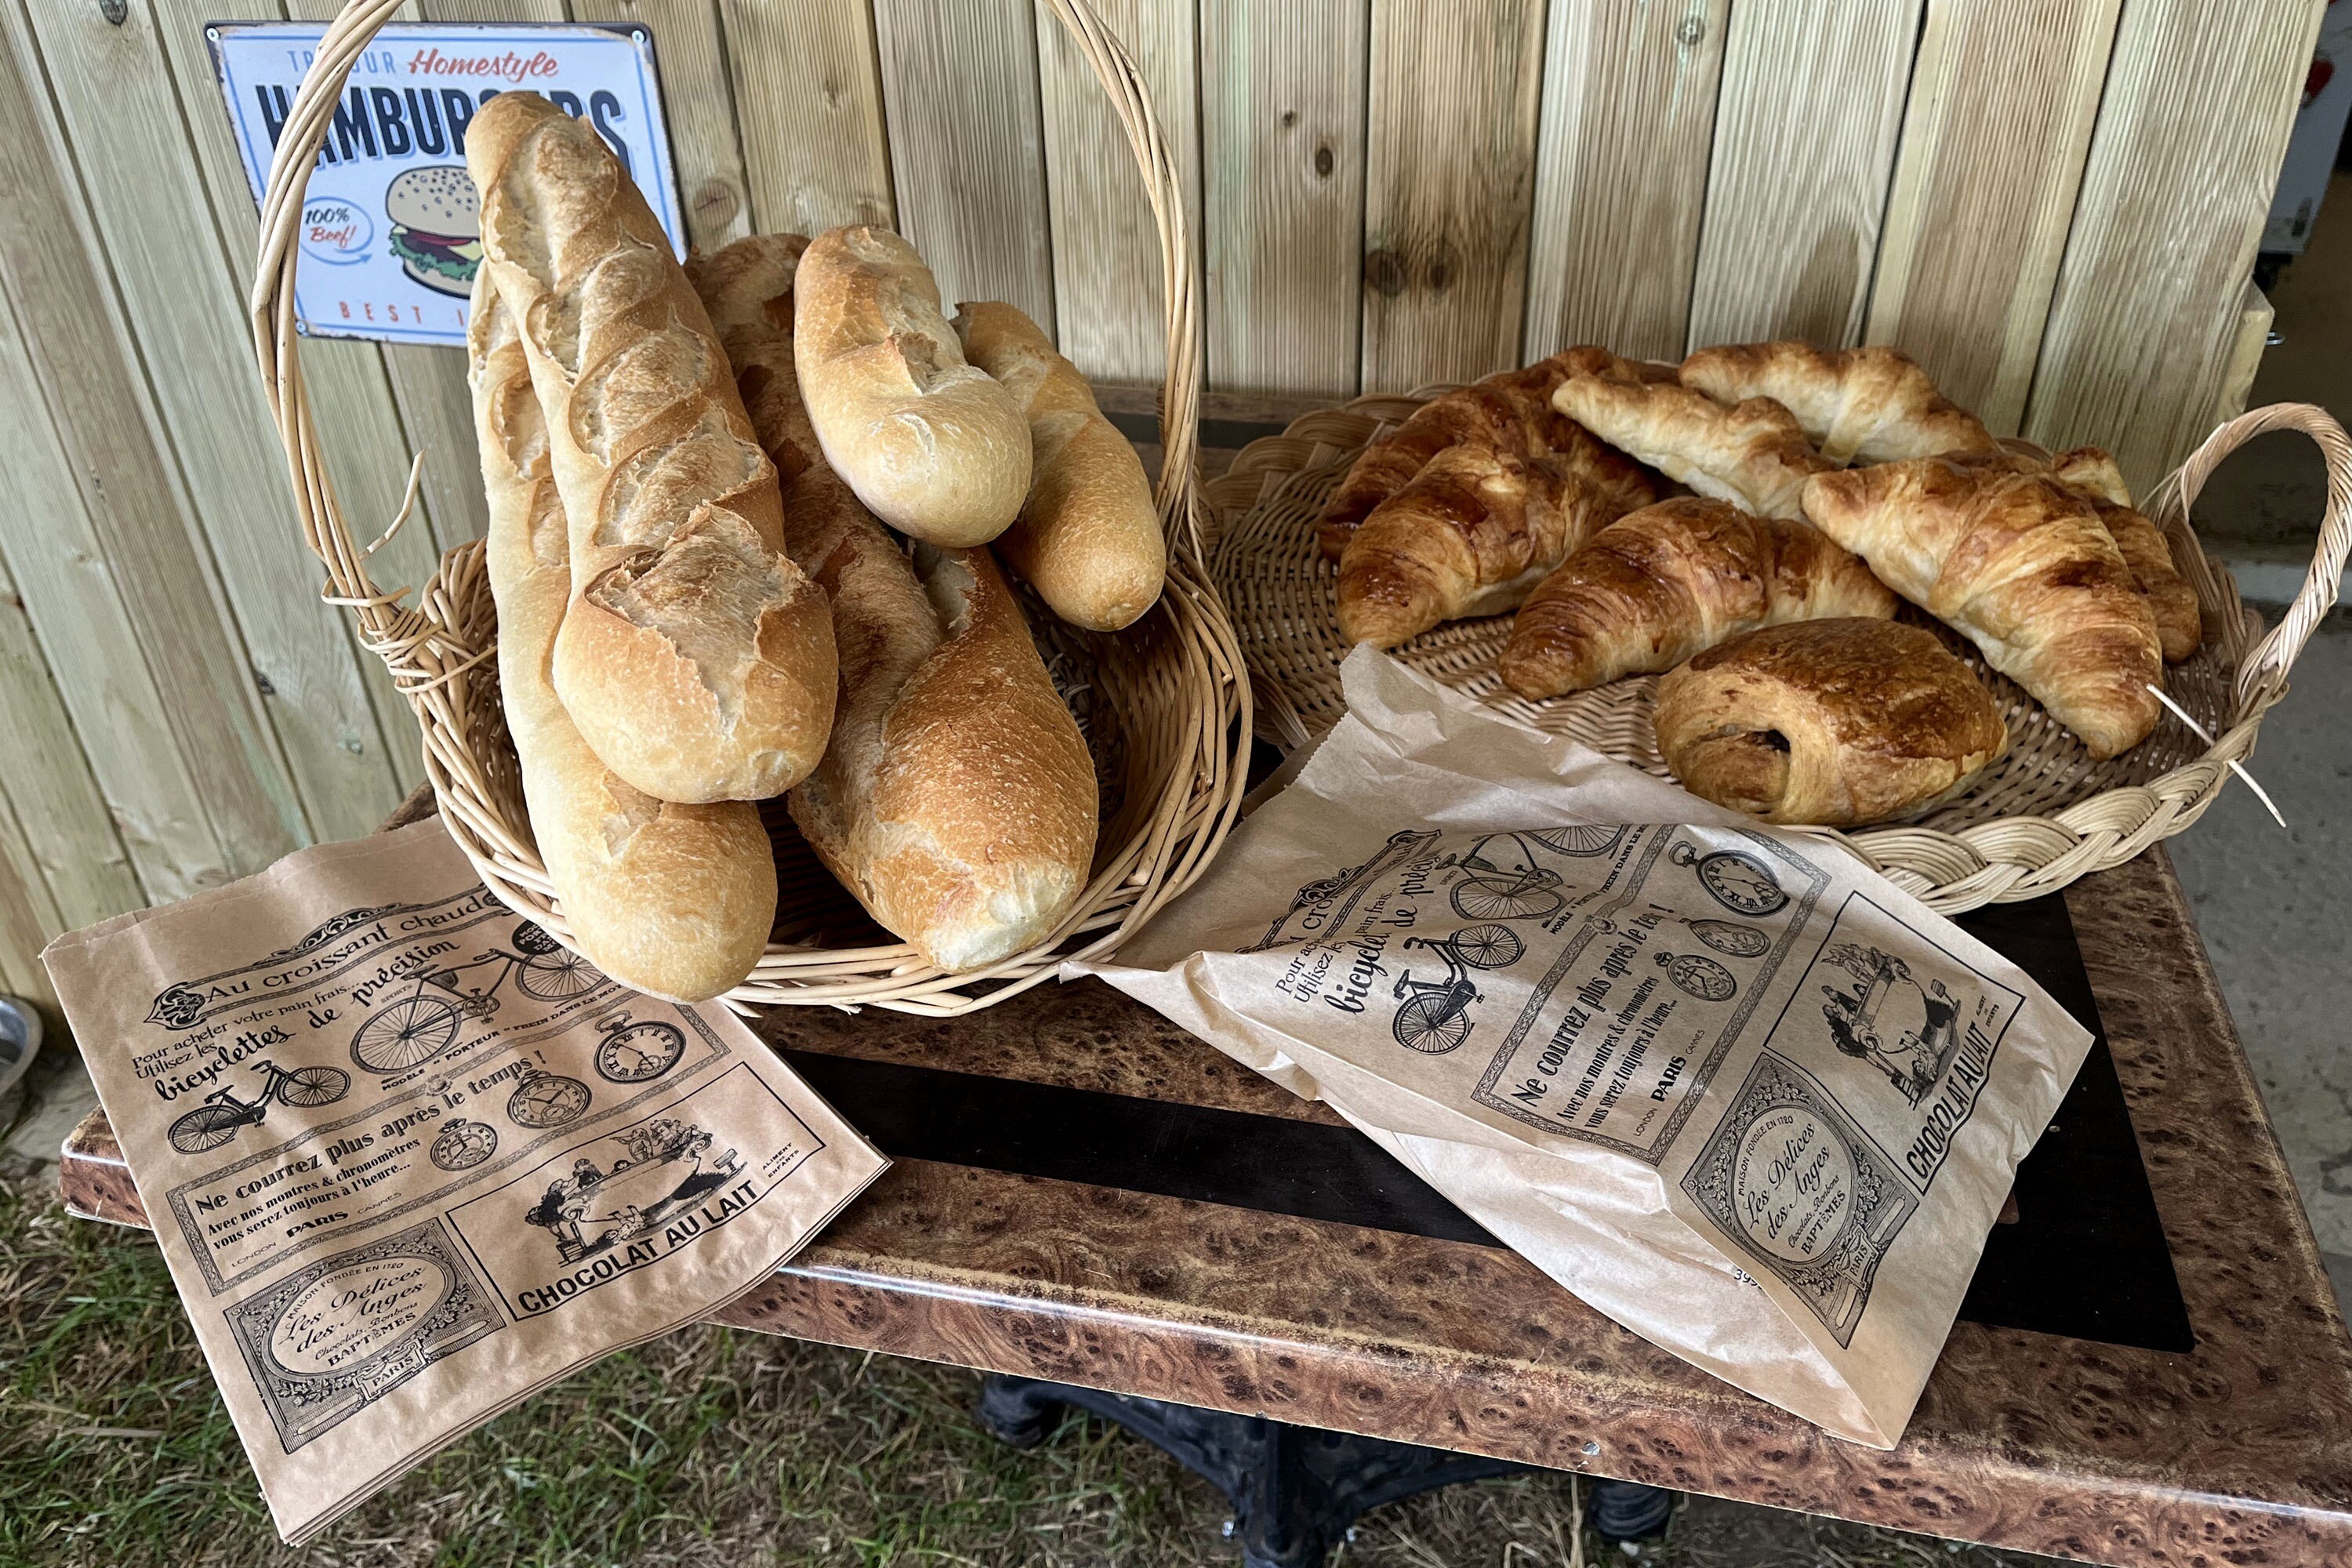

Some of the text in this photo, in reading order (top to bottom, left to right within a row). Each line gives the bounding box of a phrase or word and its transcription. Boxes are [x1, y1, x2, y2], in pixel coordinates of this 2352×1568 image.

[408, 48, 559, 83] Homestyle
[305, 207, 350, 225] 100%
[310, 225, 358, 249] Beef!
[339, 300, 422, 325] BEST
[1381, 903, 1418, 927] de
[1617, 928, 1647, 946] le
[208, 895, 485, 1004] Au croissant chaud
[1275, 957, 1306, 996] Pour
[1599, 942, 1638, 978] après
[380, 983, 414, 1004] SPORTS
[1294, 952, 1334, 1004] Utilisez
[1576, 976, 1613, 1013] plus
[132, 1047, 169, 1069] Pour
[173, 1022, 229, 1051] acheter
[233, 1009, 274, 1025] votre
[278, 1000, 312, 1017] pain
[154, 940, 461, 1102] bicyclettes de précision
[382, 1067, 426, 1091] MODÈLE
[512, 1018, 549, 1032] FREIN
[550, 1003, 582, 1021] DANS
[583, 996, 597, 1006] LE
[1537, 1006, 1591, 1076] courrez
[134, 1041, 218, 1080] Utilisez les
[1556, 975, 1660, 1123] Avec nos montres & chronomètres
[1511, 1078, 1548, 1107] Ne
[1584, 1106, 1610, 1129] vous
[1599, 1079, 1627, 1109] serez
[1613, 1035, 1651, 1081] toujours
[1635, 1028, 1656, 1040] à
[1633, 1029, 1705, 1137] LONDON PARIS CANNES
[1906, 1020, 1991, 1179] CHOCOLAT AU LAIT
[196, 1191, 229, 1216] Ne
[235, 1153, 323, 1200] courrez
[325, 1131, 376, 1165] plus
[381, 1103, 441, 1138] après
[441, 1091, 466, 1110] le
[466, 1056, 534, 1095] temps
[762, 1142, 792, 1171] ALIMENT
[768, 1149, 800, 1178] ENFANTS
[1737, 1116, 1794, 1196] MAISON FONDÉE EN 1720
[207, 1217, 238, 1237] Avec
[240, 1205, 264, 1222] nos
[265, 1181, 320, 1210] montres
[321, 1176, 336, 1188] &
[336, 1137, 422, 1183] chronomètres
[1744, 1122, 1816, 1230] Les Délices
[1767, 1145, 1831, 1240] des Anges
[1813, 1174, 1840, 1212] Bonbons
[212, 1229, 245, 1251] vous
[247, 1210, 283, 1236] serez
[283, 1189, 341, 1218] toujours
[342, 1185, 353, 1198] à
[231, 1192, 403, 1268] LONDON PARIS CANNES
[517, 1179, 760, 1313] CHOCOLAT AU LAIT
[1849, 1244, 1869, 1277] PARIS
[278, 1265, 427, 1346] Les Délices
[287, 1288, 319, 1320] MAISON
[320, 1268, 363, 1288] FONDÉE
[365, 1265, 379, 1273] EN
[296, 1282, 427, 1354] des Anges
[368, 1301, 419, 1329] Bonbons
[372, 1355, 415, 1387] PARIS
